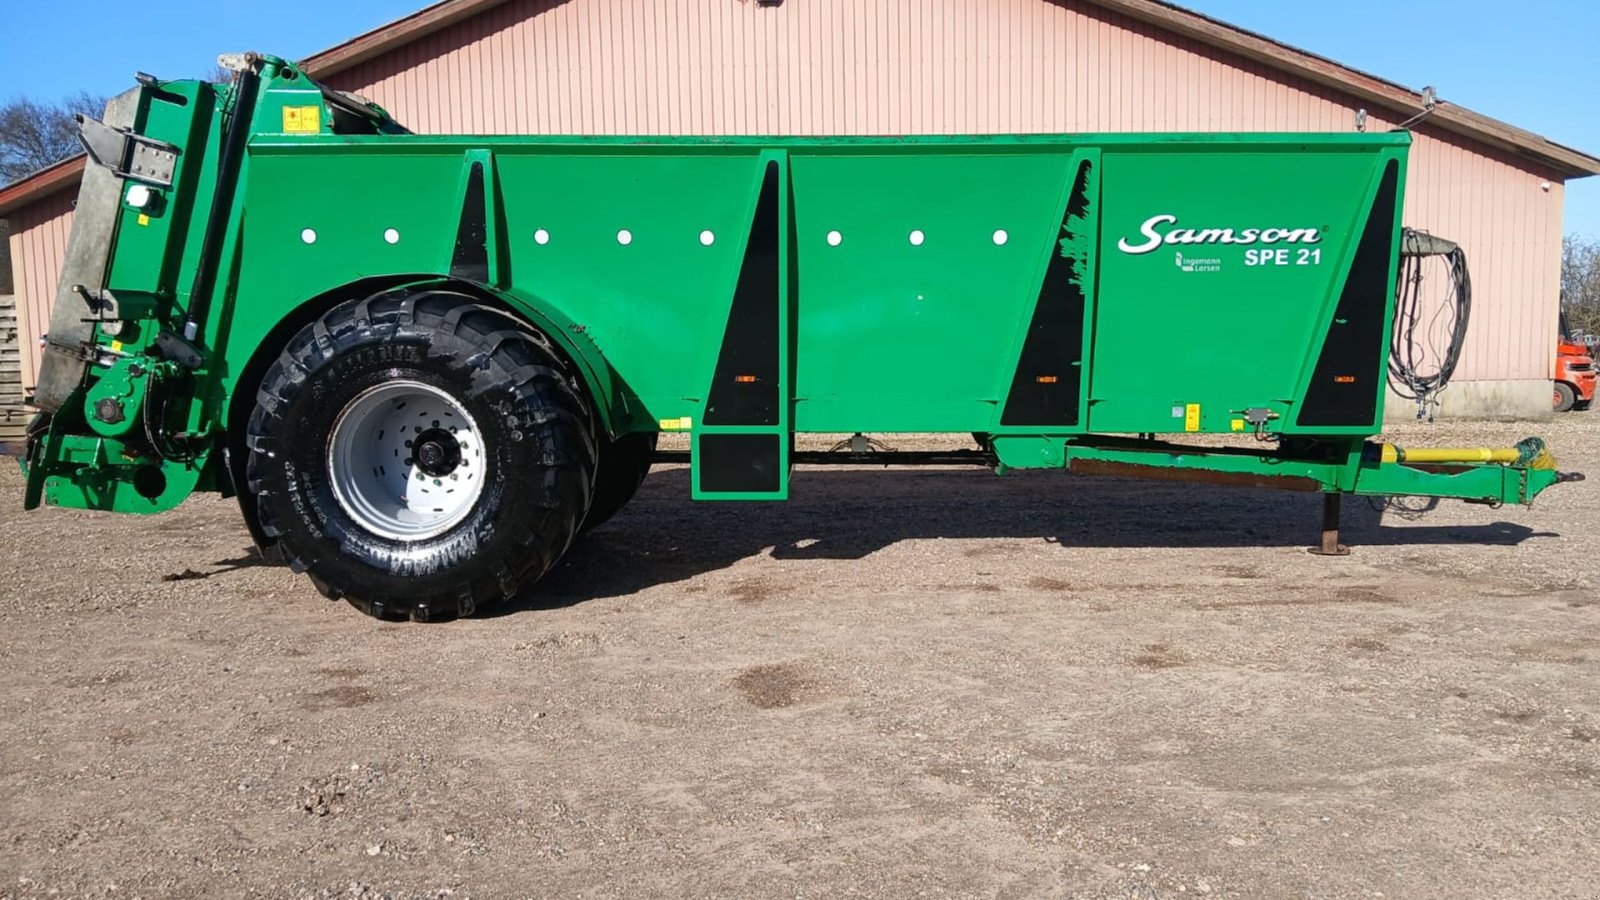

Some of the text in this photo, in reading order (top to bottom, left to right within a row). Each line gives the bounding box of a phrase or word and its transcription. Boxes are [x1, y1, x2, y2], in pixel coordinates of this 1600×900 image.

[1117, 214, 1322, 254] Samson
[1244, 248, 1321, 266] SPE 21
